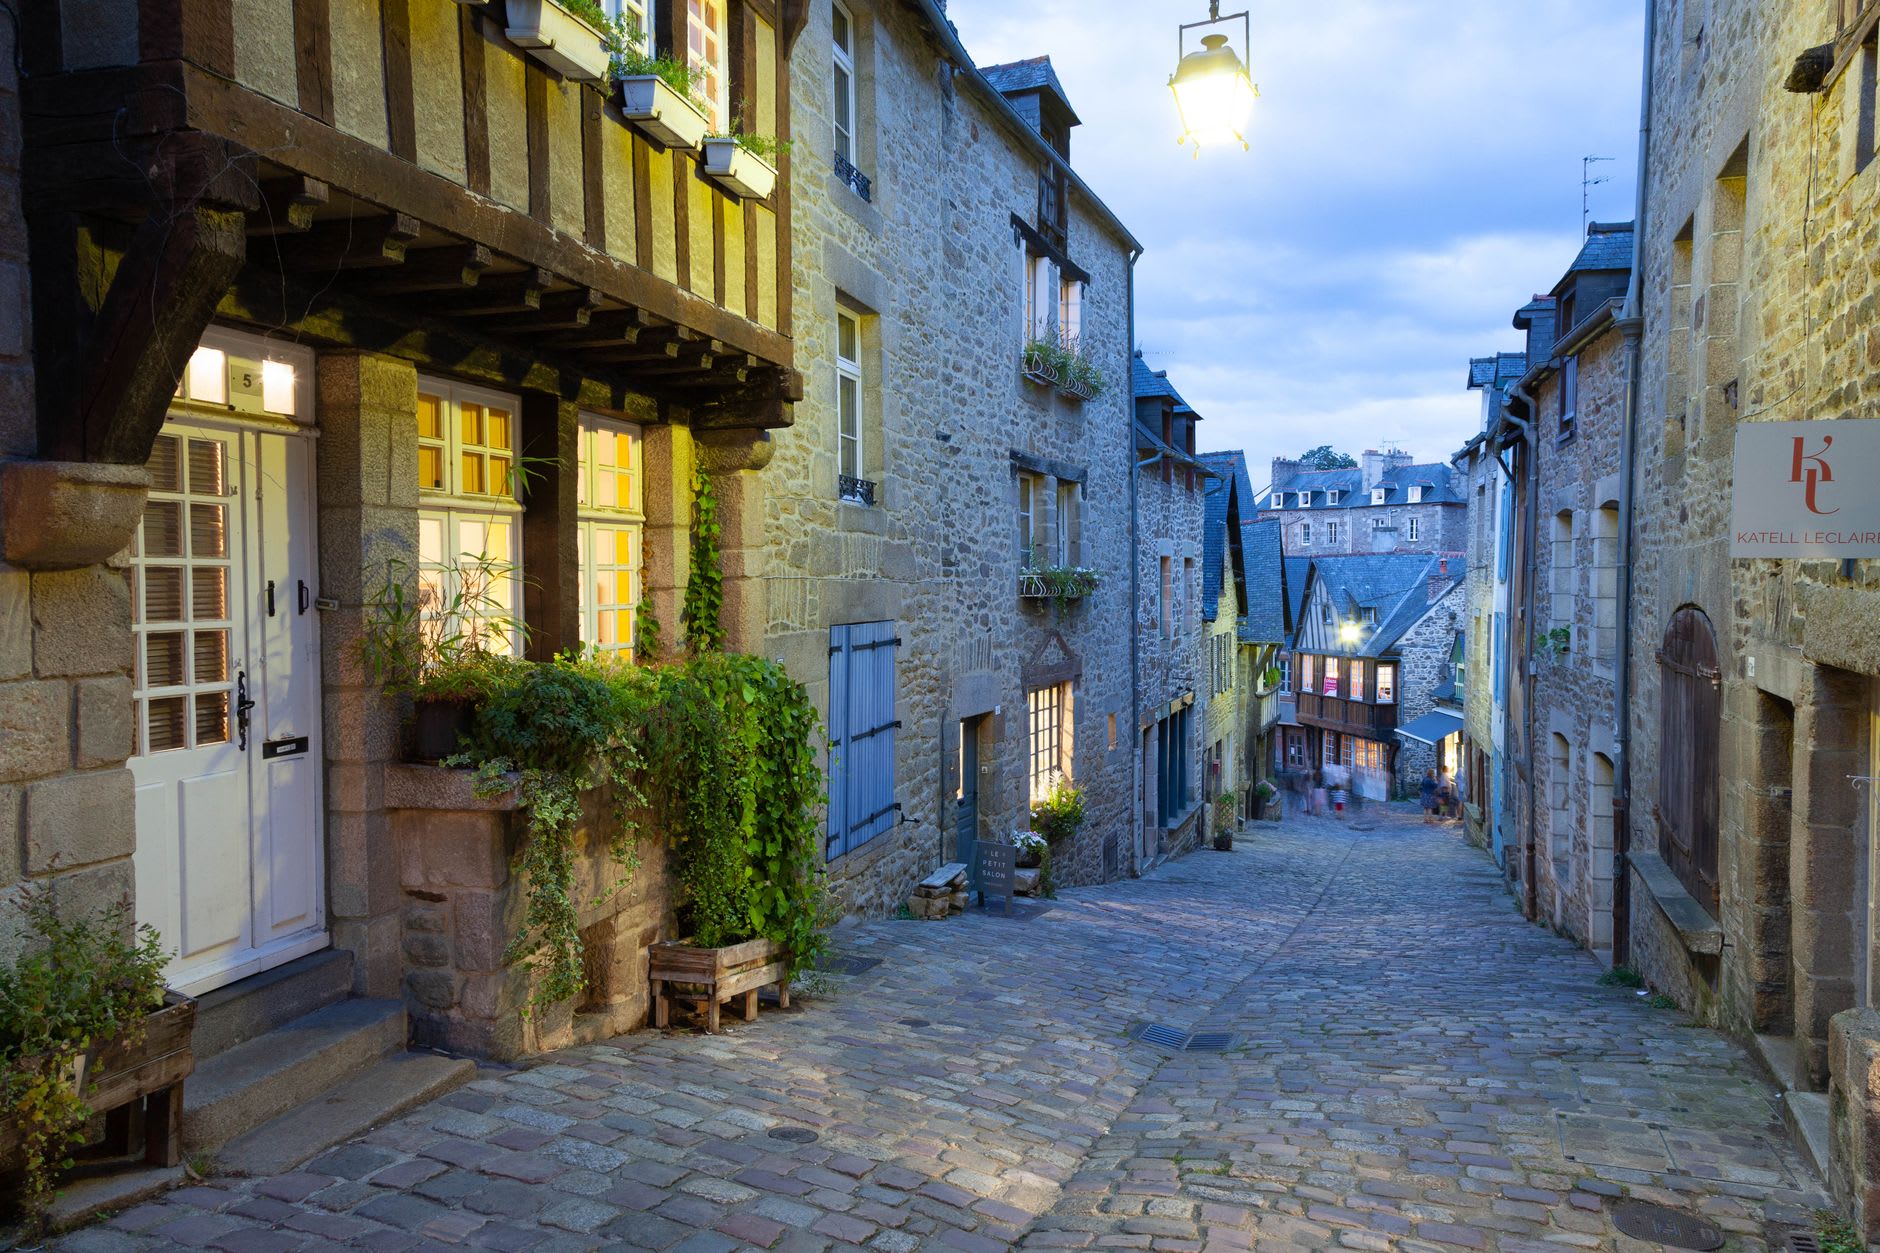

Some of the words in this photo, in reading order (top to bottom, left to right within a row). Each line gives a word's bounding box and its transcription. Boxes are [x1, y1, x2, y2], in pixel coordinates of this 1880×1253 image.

[243, 374, 252, 388] 5
[1737, 531, 1799, 544] KATELL
[1804, 531, 1880, 544] LECLAIR
[990, 850, 999, 858] LE
[982, 859, 1006, 869] PETIT
[982, 869, 1006, 879] SALON
